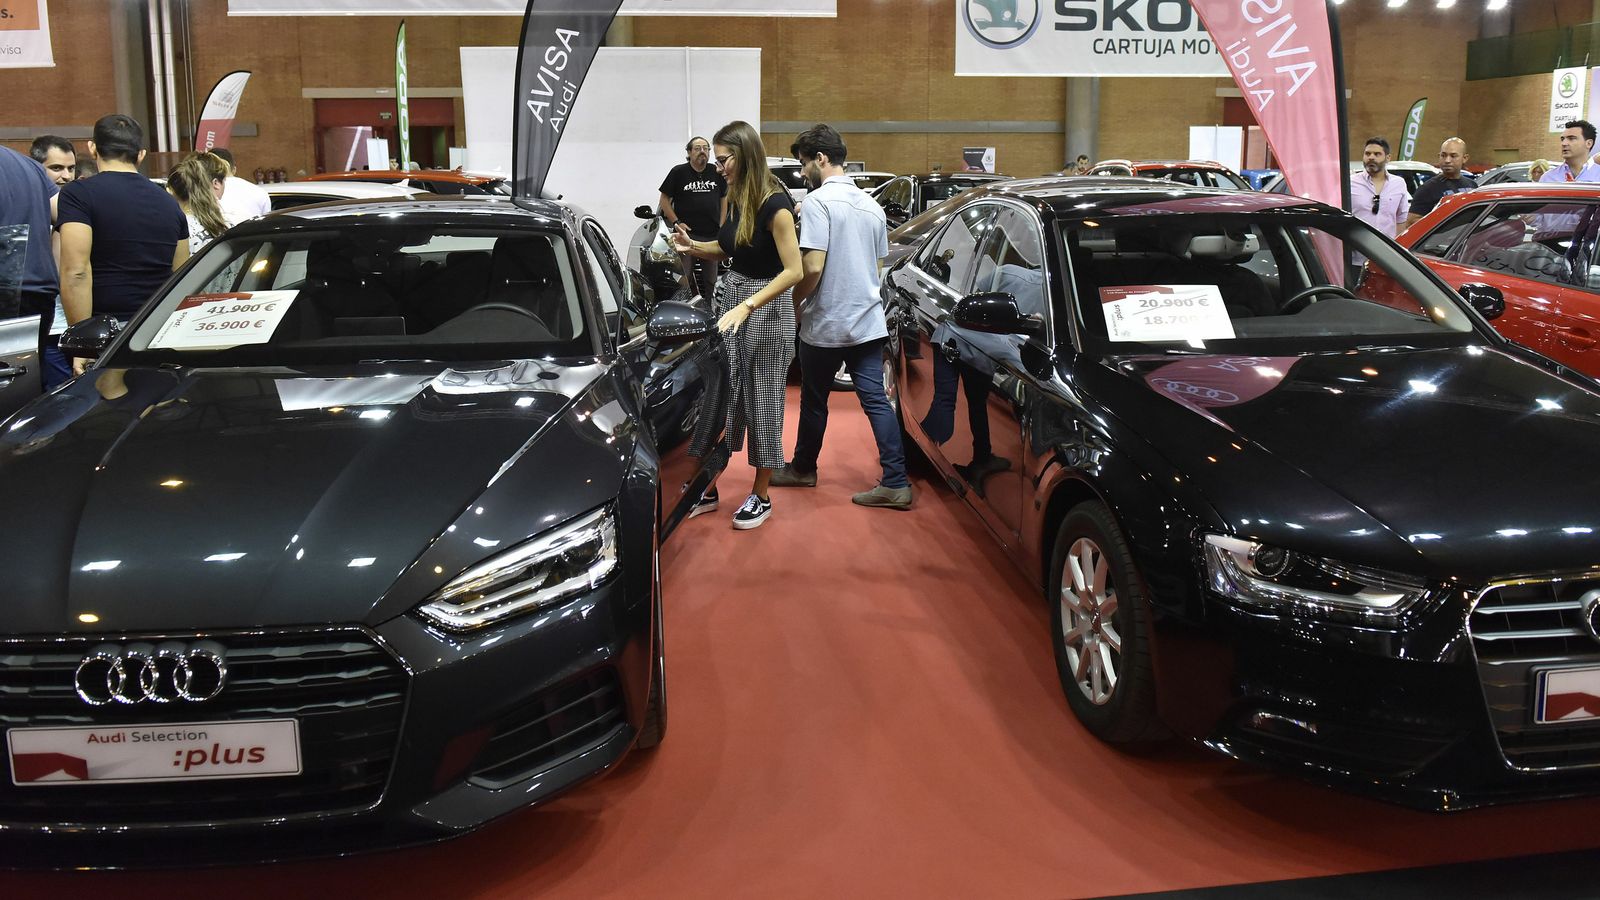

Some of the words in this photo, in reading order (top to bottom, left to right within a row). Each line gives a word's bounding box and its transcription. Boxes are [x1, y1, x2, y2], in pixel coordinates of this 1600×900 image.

[0, 44, 22, 55] visa
[1092, 38, 1176, 58] CARTUJA
[526, 27, 580, 124] AVISA
[397, 38, 410, 172] KODA
[549, 79, 577, 133] Audi
[1404, 105, 1424, 162] ODA
[206, 303, 261, 314] 41.900
[264, 303, 277, 312] €
[1198, 298, 1210, 307] €
[194, 320, 251, 332] 36.900
[254, 319, 266, 329] €
[86, 732, 127, 745] Audi
[131, 730, 209, 744] Selection
[173, 743, 266, 771] :plus
